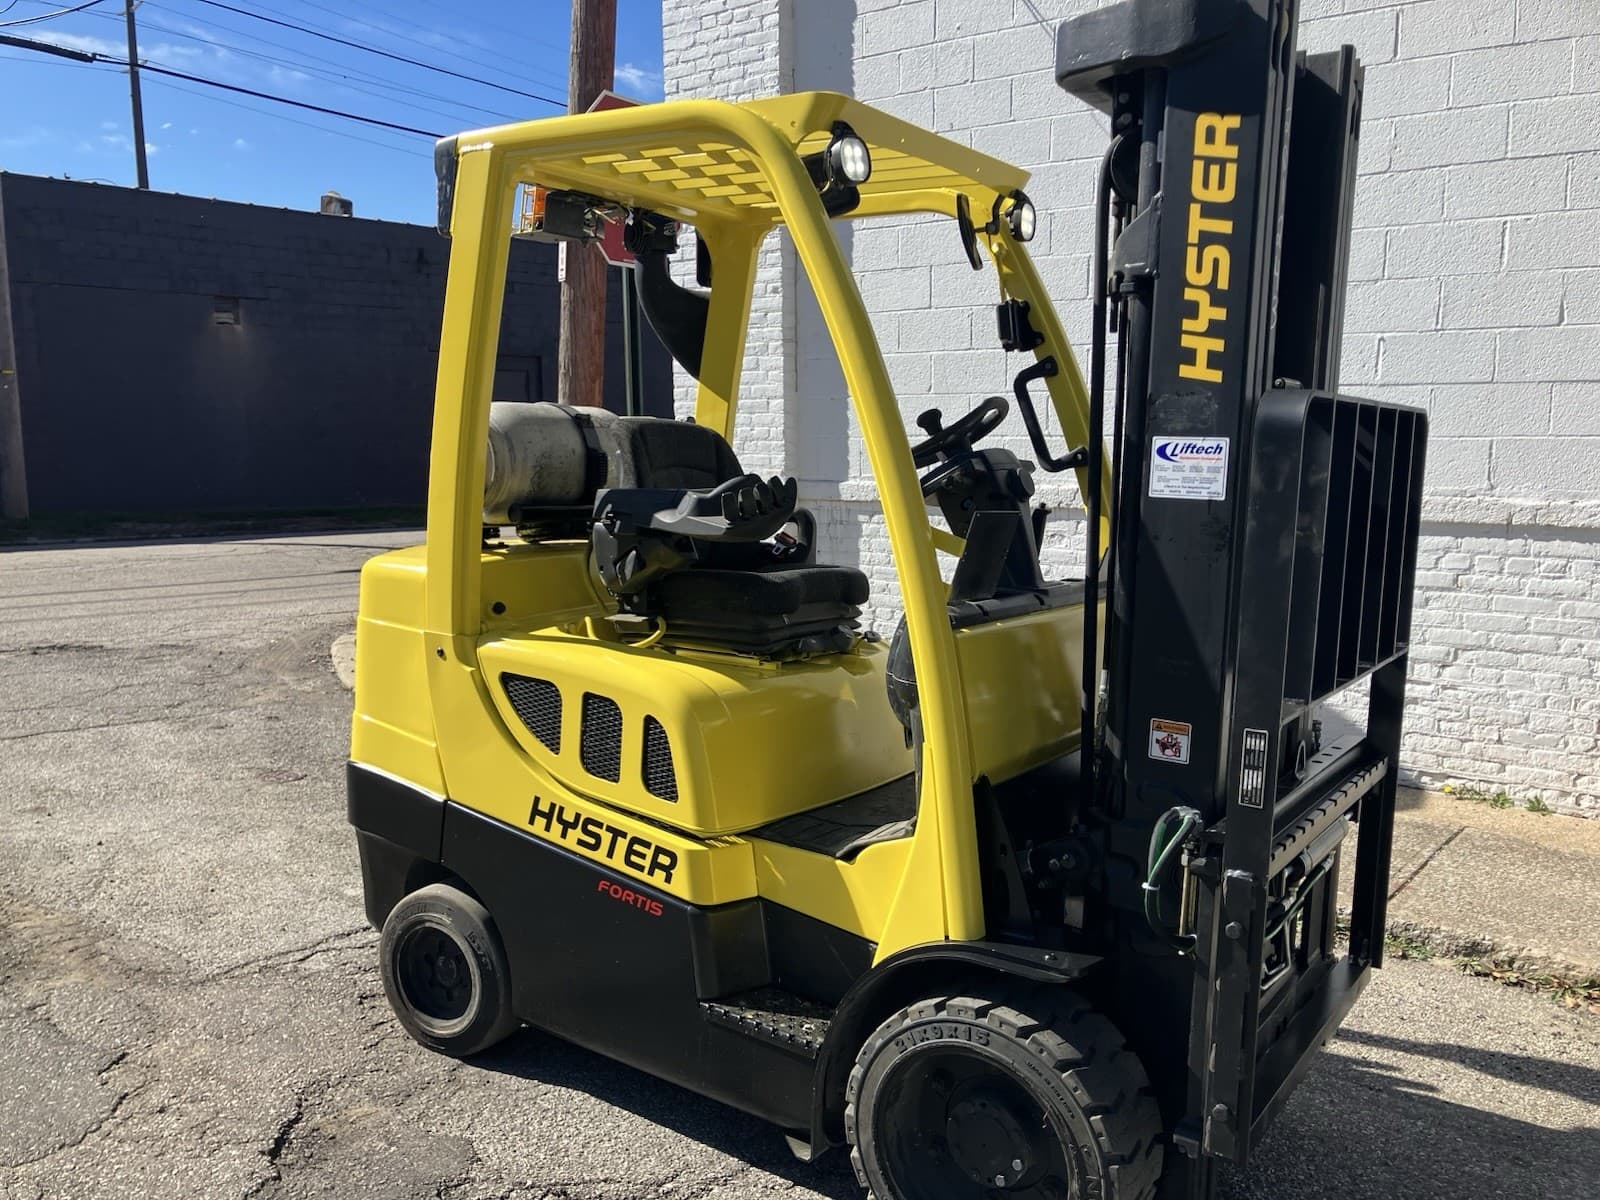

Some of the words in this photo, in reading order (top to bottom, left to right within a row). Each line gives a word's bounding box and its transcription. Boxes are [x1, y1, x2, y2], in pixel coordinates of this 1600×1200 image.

[1178, 112, 1242, 383] HYSTER
[1170, 442, 1223, 457] Liftech
[527, 795, 678, 885] HYSTER
[598, 880, 663, 917] FORTIS
